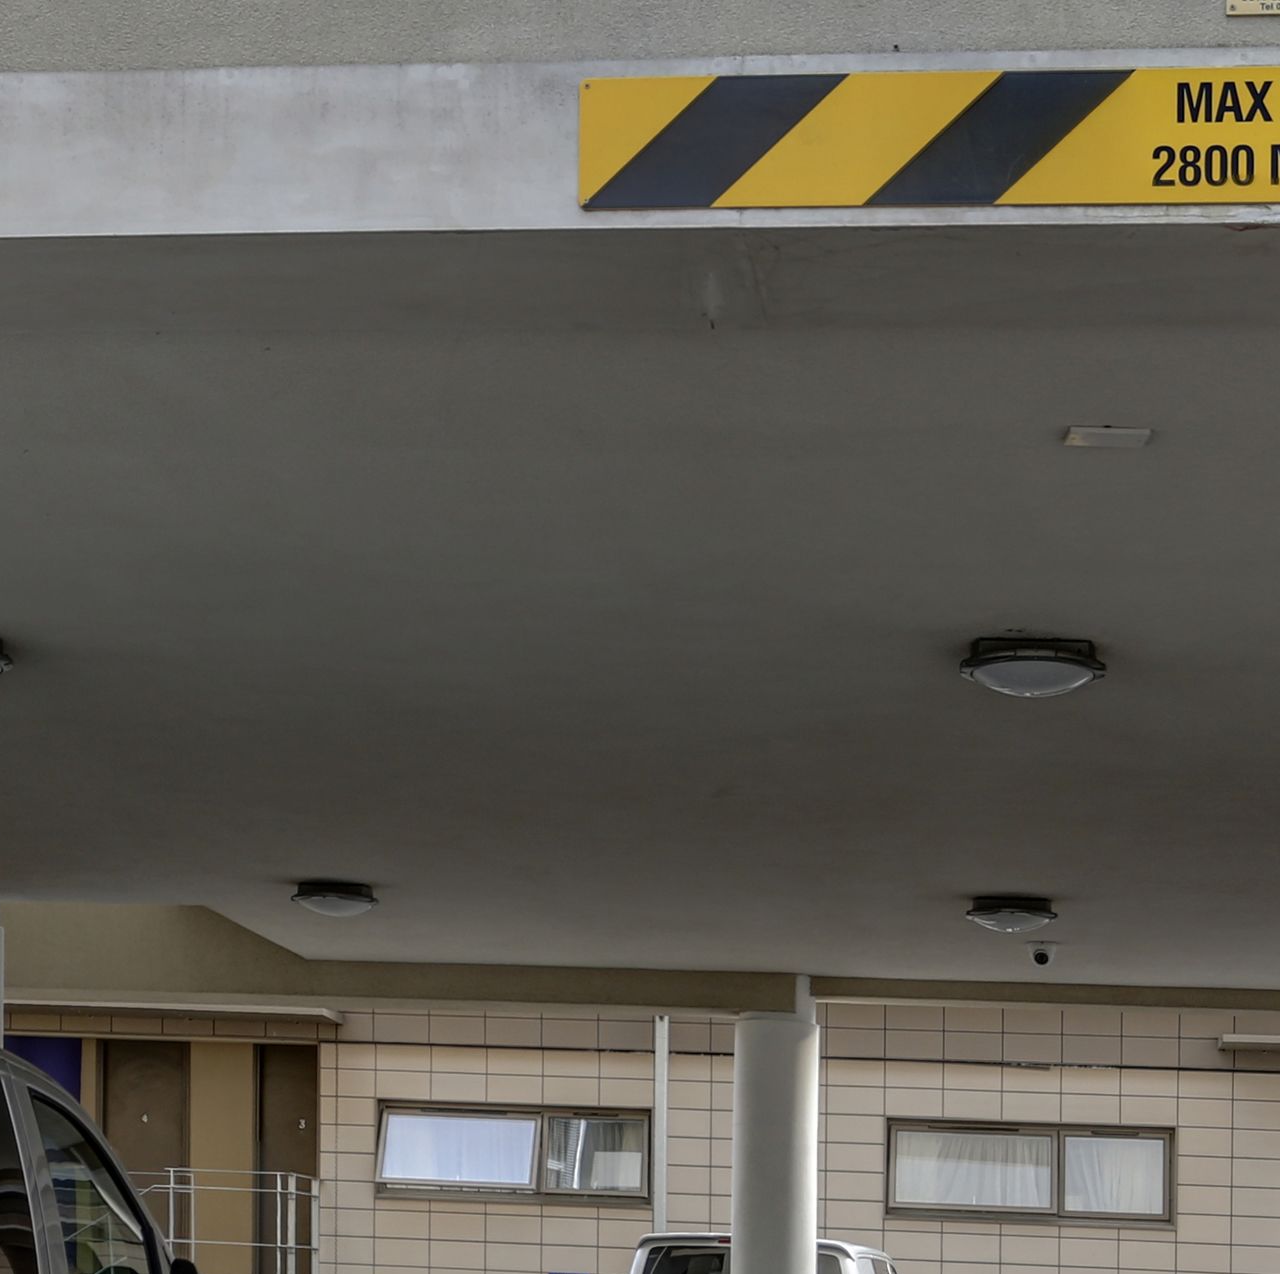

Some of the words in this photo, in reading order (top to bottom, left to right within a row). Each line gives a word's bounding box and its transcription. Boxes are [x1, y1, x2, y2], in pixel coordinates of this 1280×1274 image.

[1260, 2, 1274, 11] Tel
[1176, 80, 1273, 124] MAX
[1151, 144, 1255, 187] 2800
[298, 1118, 306, 1129] 3
